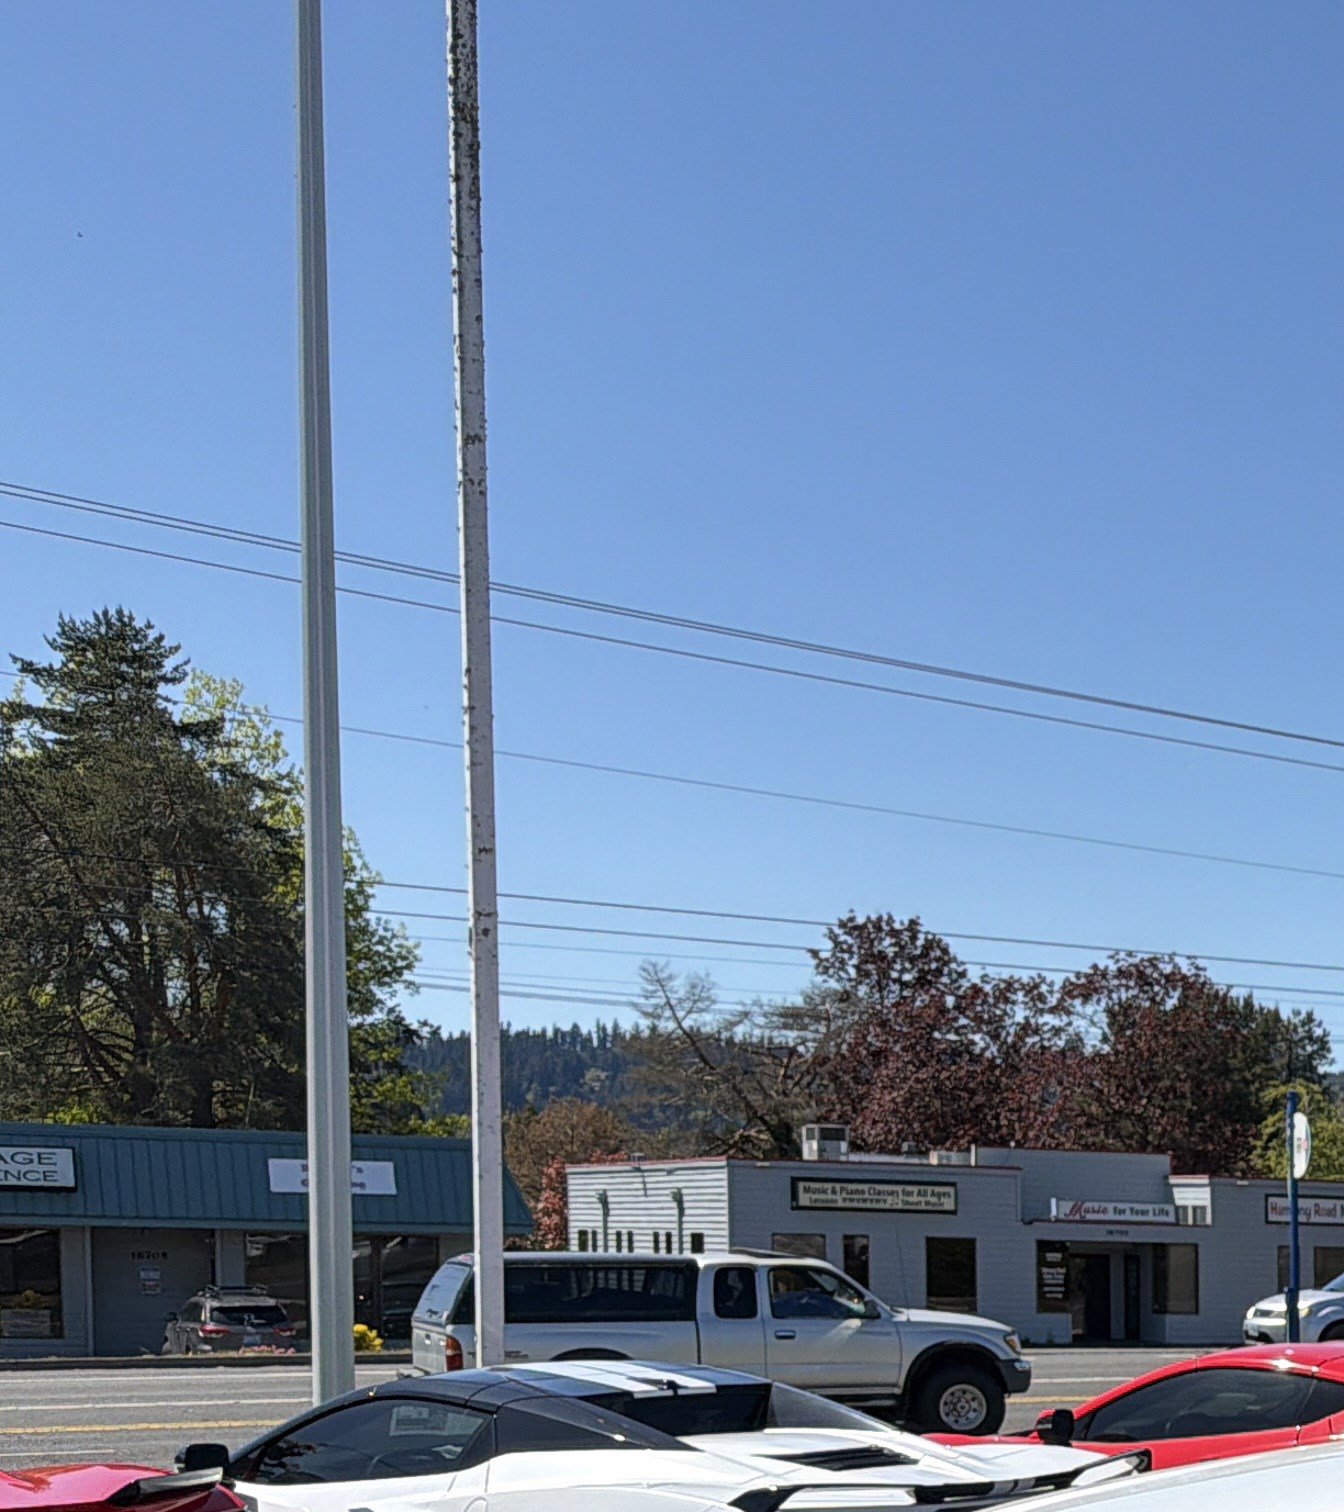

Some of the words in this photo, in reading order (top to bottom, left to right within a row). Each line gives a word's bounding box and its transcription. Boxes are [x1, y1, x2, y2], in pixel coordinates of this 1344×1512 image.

[0, 1168, 59, 1182] NCE
[803, 1184, 828, 1196] Music
[839, 1185, 866, 1196] Piano
[916, 1188, 929, 1198] All
[1064, 1200, 1109, 1220] Music
[1130, 1206, 1150, 1217] Your
[1270, 1202, 1312, 1222] Harny
[1313, 1202, 1338, 1218] Road
